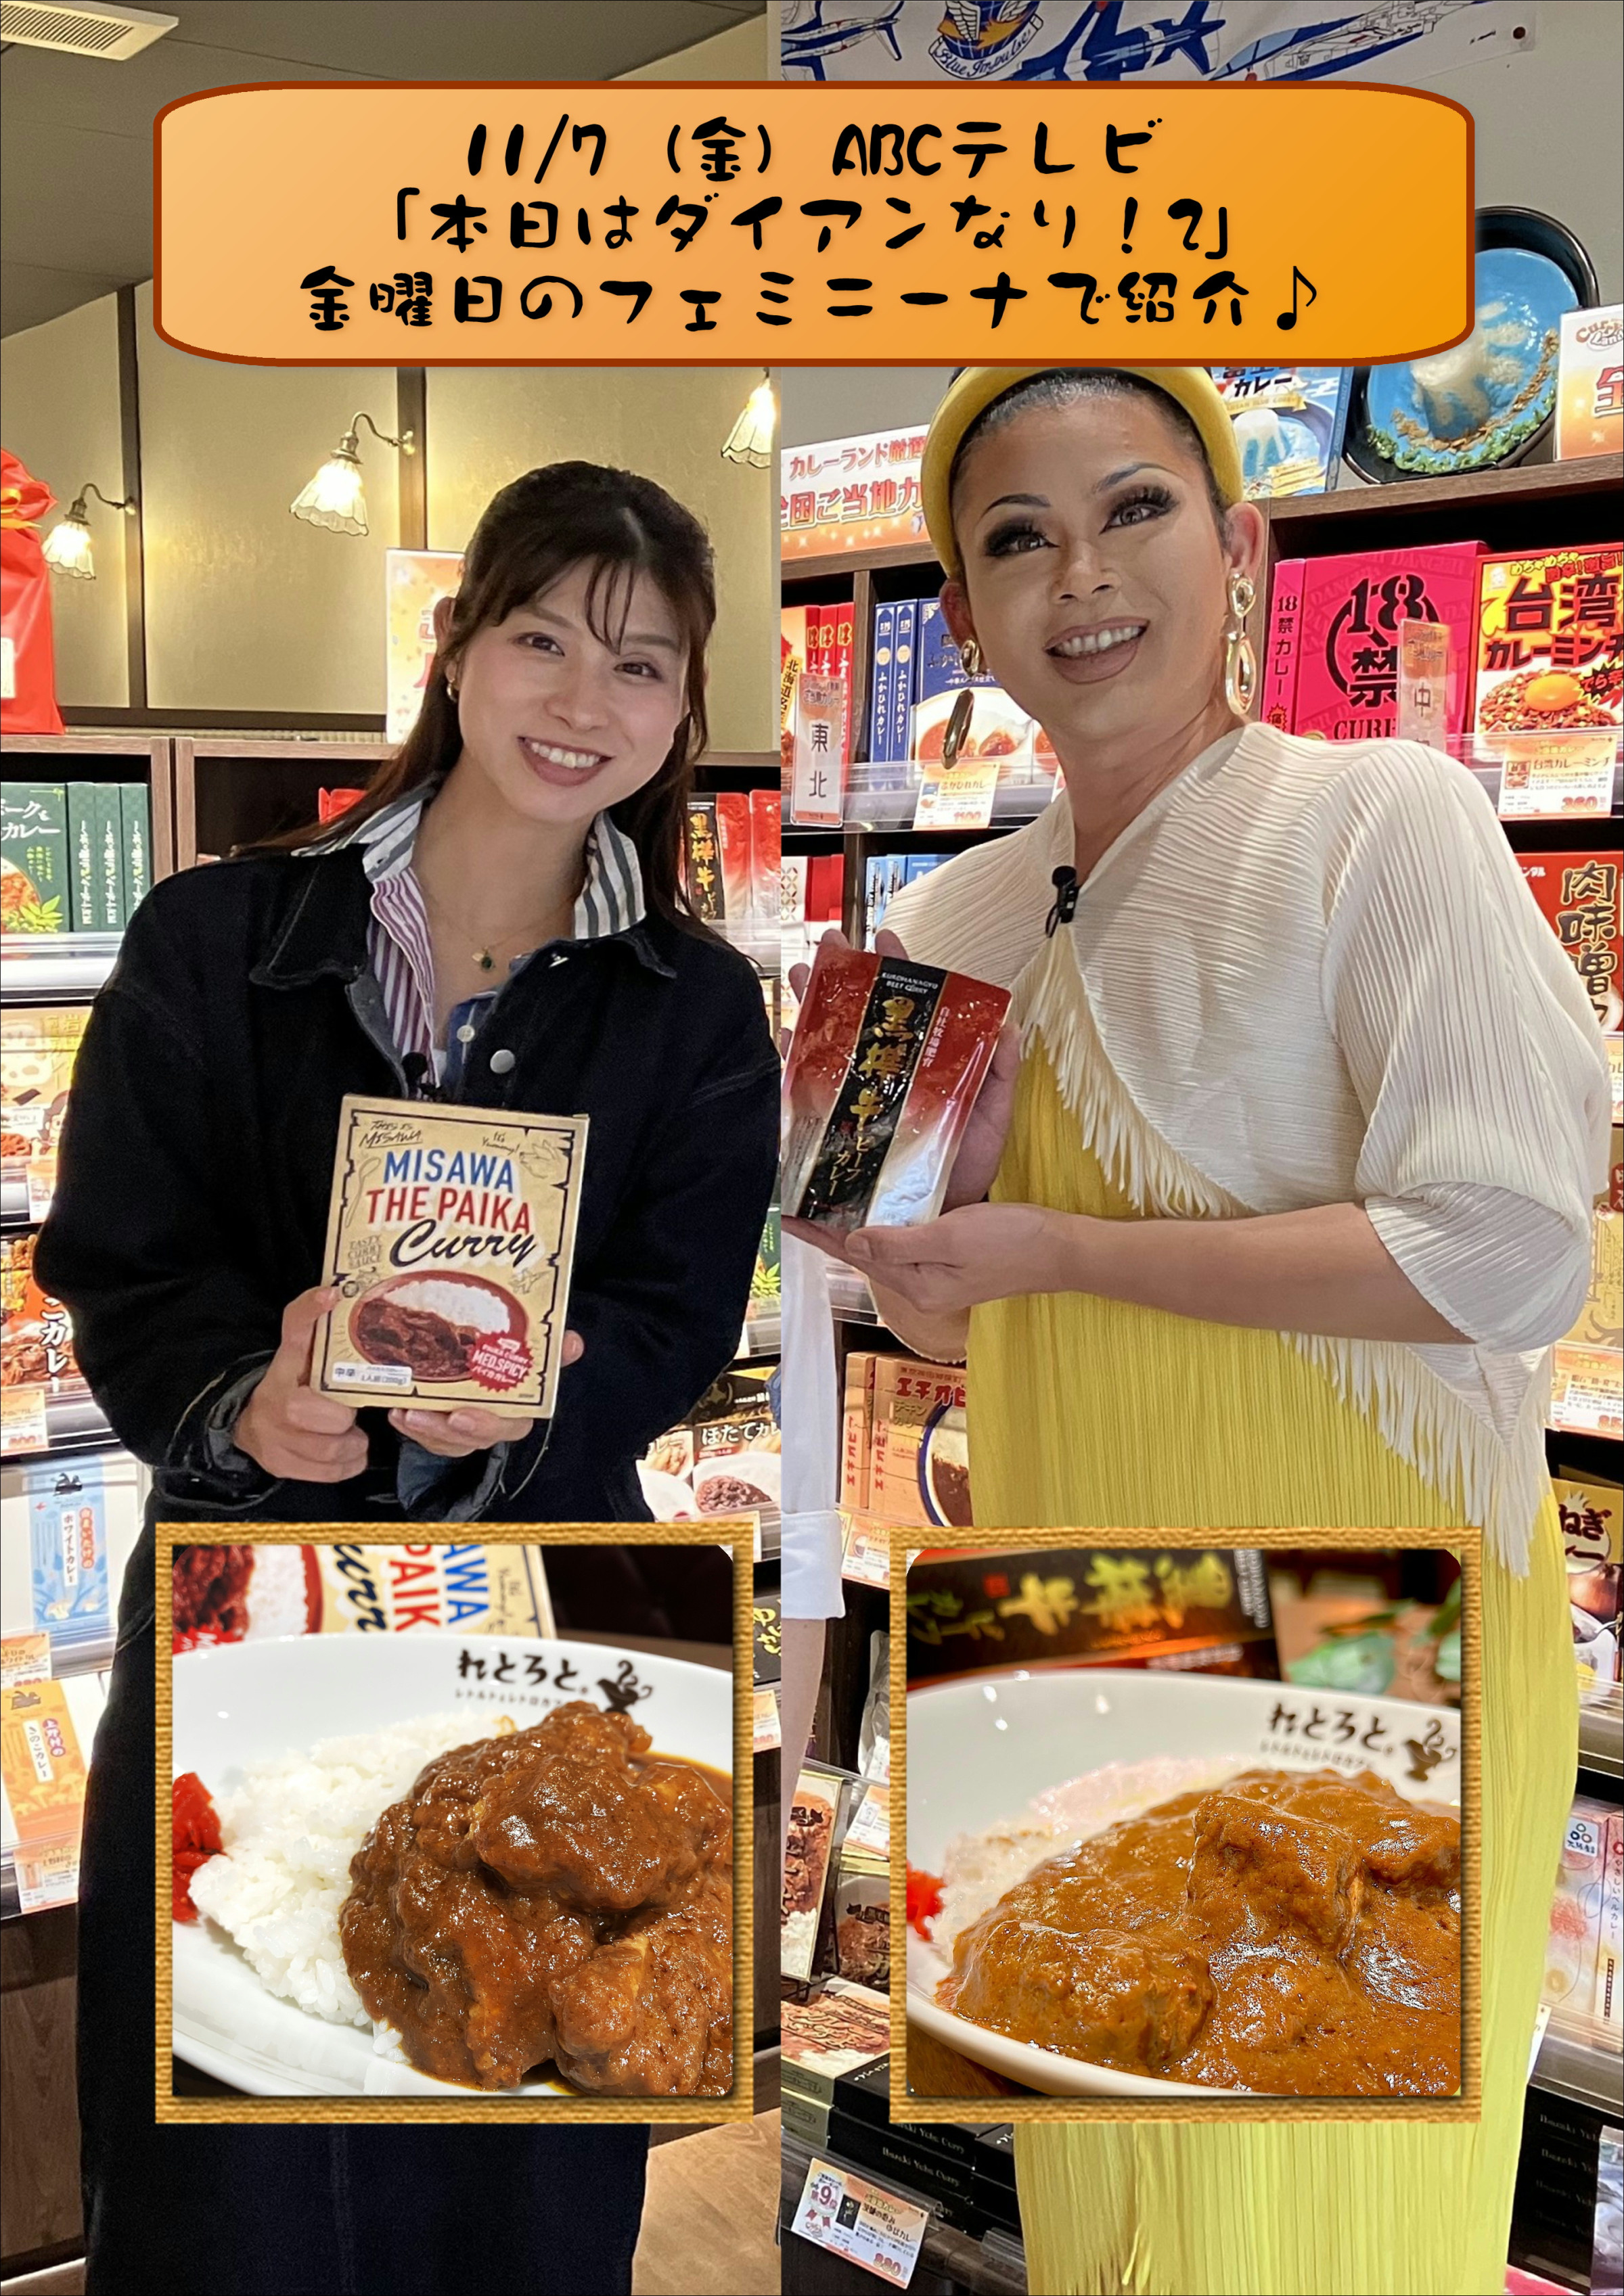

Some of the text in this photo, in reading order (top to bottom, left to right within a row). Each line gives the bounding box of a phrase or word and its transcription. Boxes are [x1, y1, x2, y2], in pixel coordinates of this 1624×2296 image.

[933, 29, 1032, 76] Blue Impulse
[1234, 377, 1292, 398] カレー
[1347, 574, 1425, 634] 18
[1506, 575, 1620, 632] 台湾
[1275, 595, 1298, 696] 18禁カレー
[1350, 646, 1399, 708] 禁
[876, 671, 888, 745] ふかひれカレー
[896, 669, 907, 743] ふかひれカレー
[809, 722, 830, 799] 東北
[1, 821, 62, 841] カレー
[359, 1129, 423, 1149] MISAWA
[383, 1149, 514, 1194] MISAWA
[365, 1187, 530, 1236] THE PAIKA
[389, 1218, 537, 1268] Curry
[64, 1514, 75, 1584] ホワイトカレー
